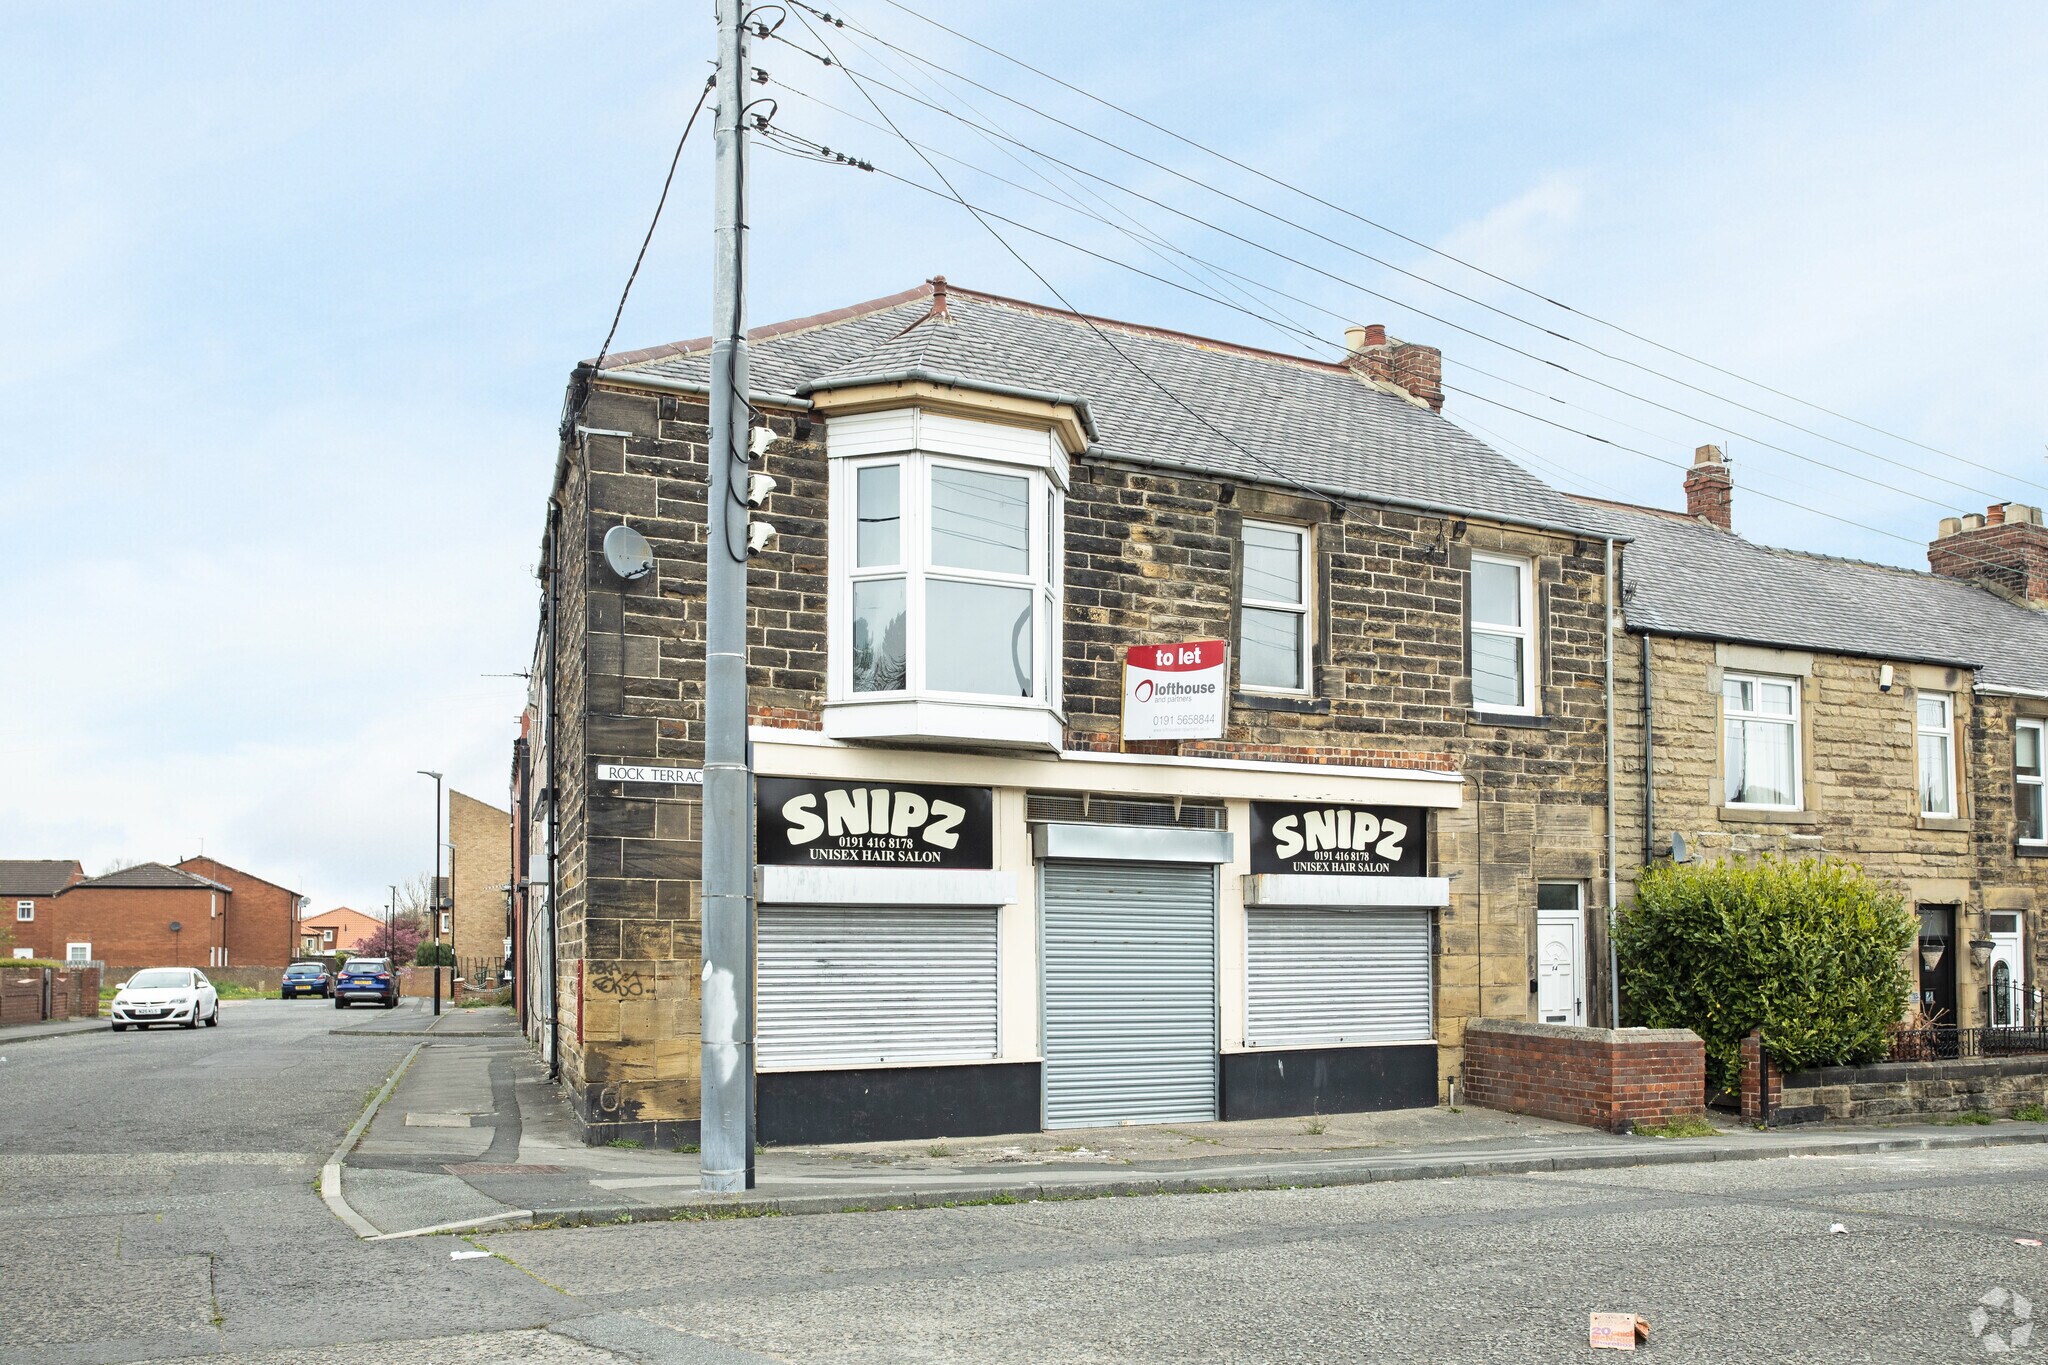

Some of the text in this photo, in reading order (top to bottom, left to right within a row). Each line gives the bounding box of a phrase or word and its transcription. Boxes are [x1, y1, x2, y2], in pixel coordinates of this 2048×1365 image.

[1155, 647, 1201, 666] to let
[1154, 682, 1215, 696] lofthouse
[1154, 695, 1192, 704] and partners
[1153, 714, 1215, 726] 0191 5658844
[609, 767, 703, 783] ROCK TERRAC
[781, 787, 966, 850] SNIPZ
[1271, 808, 1408, 862] SNIPZ
[839, 836, 914, 850] 0191 416 8178
[809, 848, 941, 863] UNISEX HAIR SALON
[1314, 851, 1370, 861] 0191 416 8178
[1293, 861, 1390, 873] UNISEX HAIR SALON
[1592, 1327, 1611, 1335] 20
